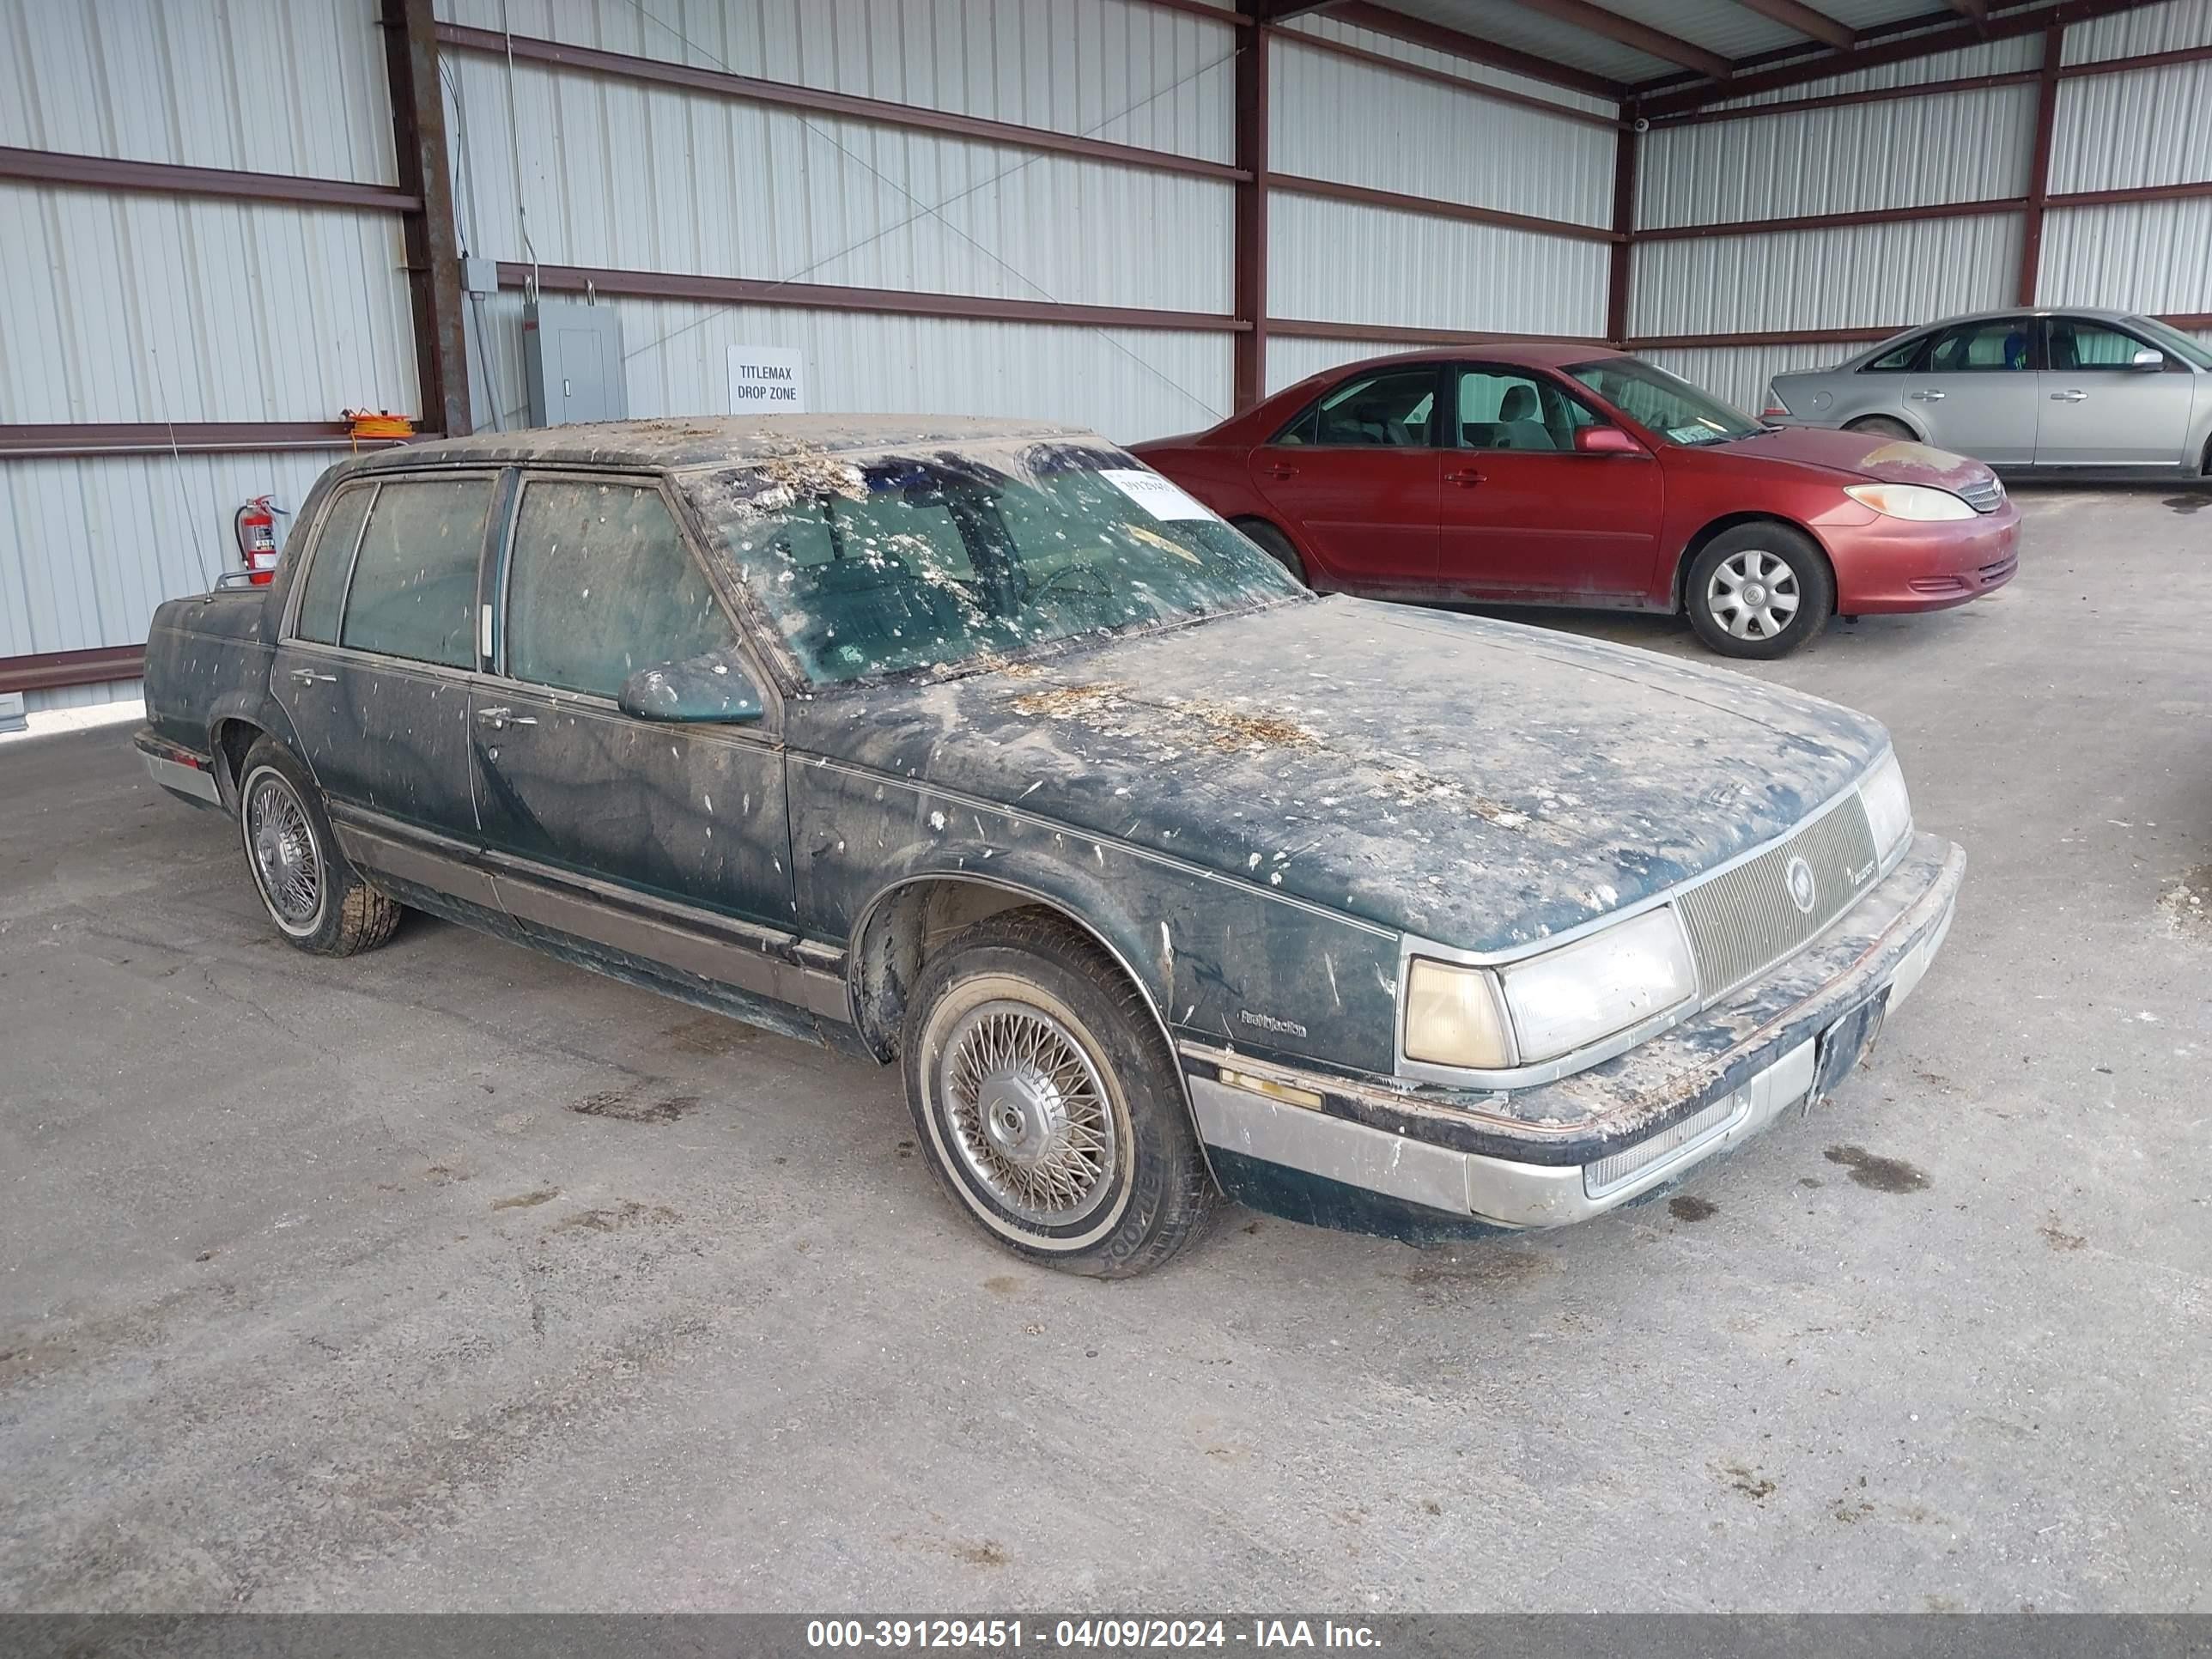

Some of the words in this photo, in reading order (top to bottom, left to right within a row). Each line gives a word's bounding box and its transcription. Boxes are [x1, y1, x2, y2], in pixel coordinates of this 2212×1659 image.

[740, 365, 792, 380] TITLEMAX
[738, 385, 767, 399] DROP
[769, 386, 797, 400] ZONE
